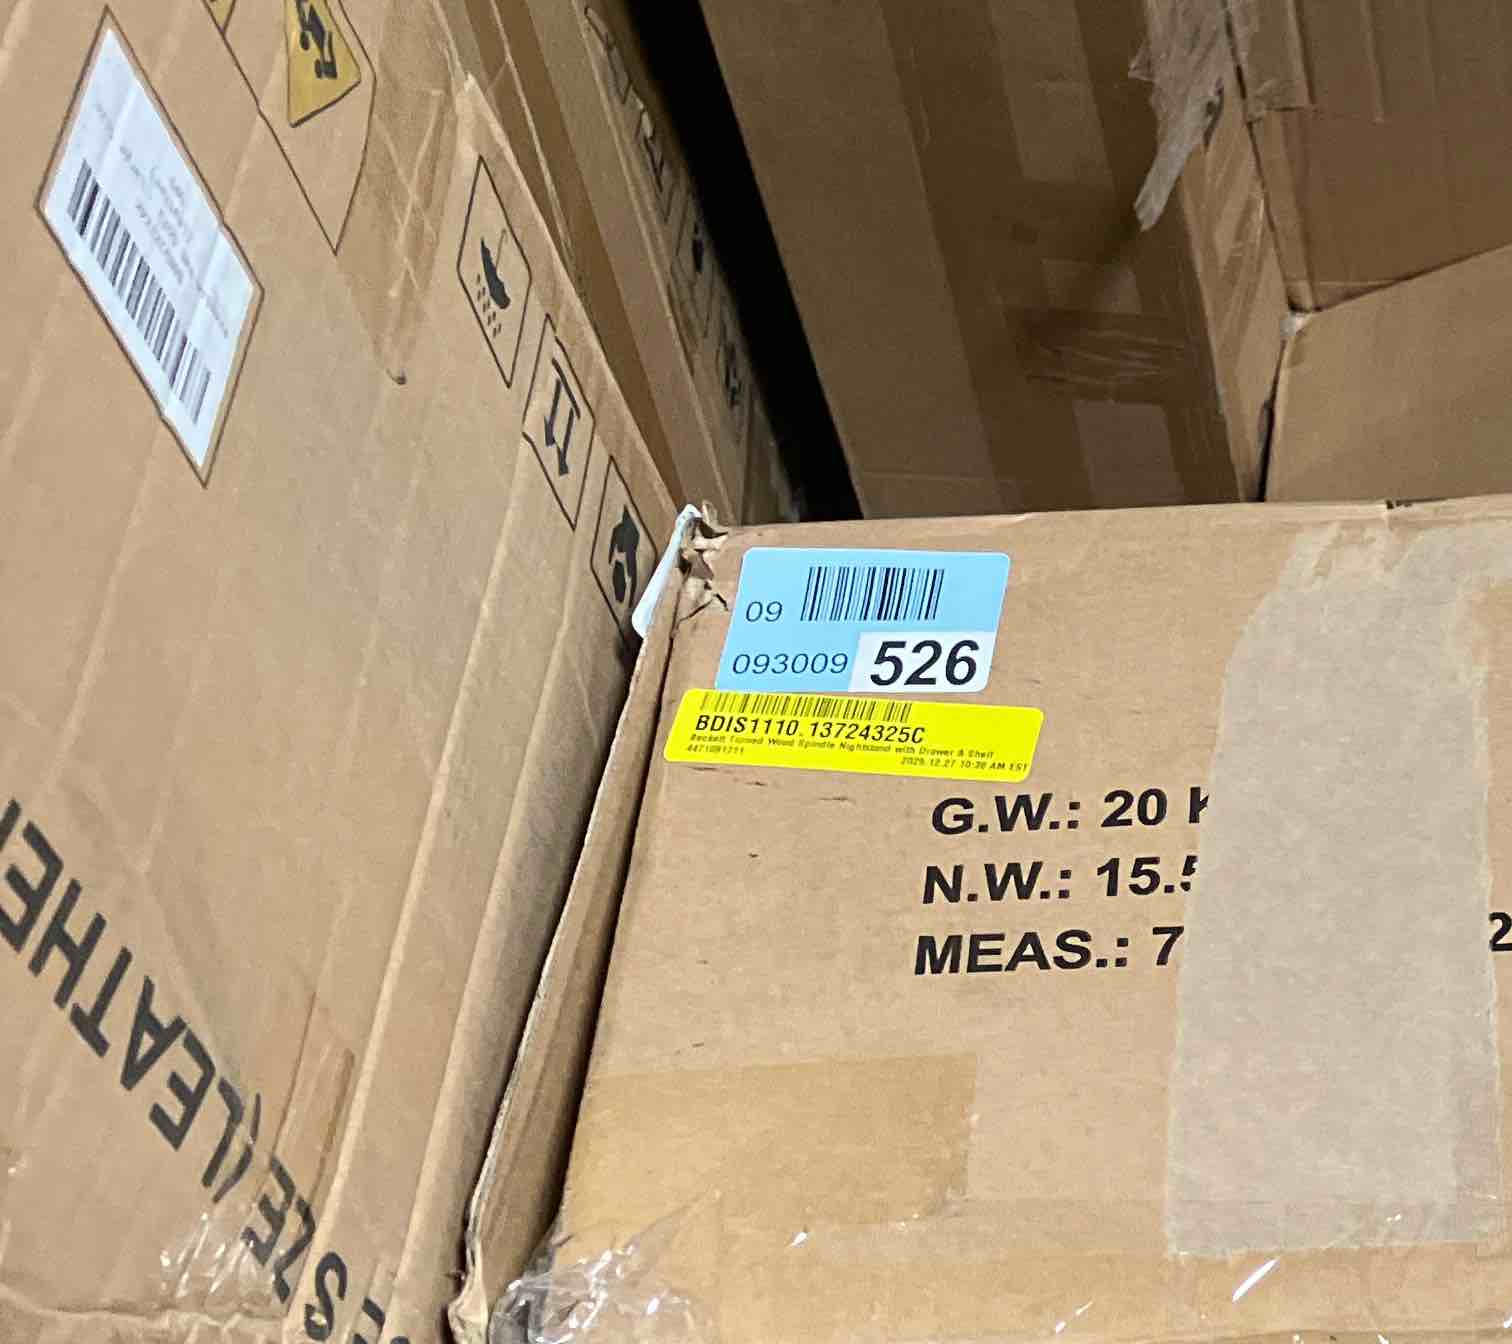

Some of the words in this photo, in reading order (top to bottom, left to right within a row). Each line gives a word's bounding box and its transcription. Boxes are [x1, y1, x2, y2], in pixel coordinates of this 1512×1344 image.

[745, 600, 783, 623] 09
[731, 652, 849, 675] 093009
[869, 639, 980, 687] 526
[895, 745, 915, 755] with
[931, 792, 1081, 835] G.W.:
[1100, 788, 1168, 828] 20
[922, 860, 1073, 904] N.W.:
[914, 928, 1129, 976] MEAS.:
